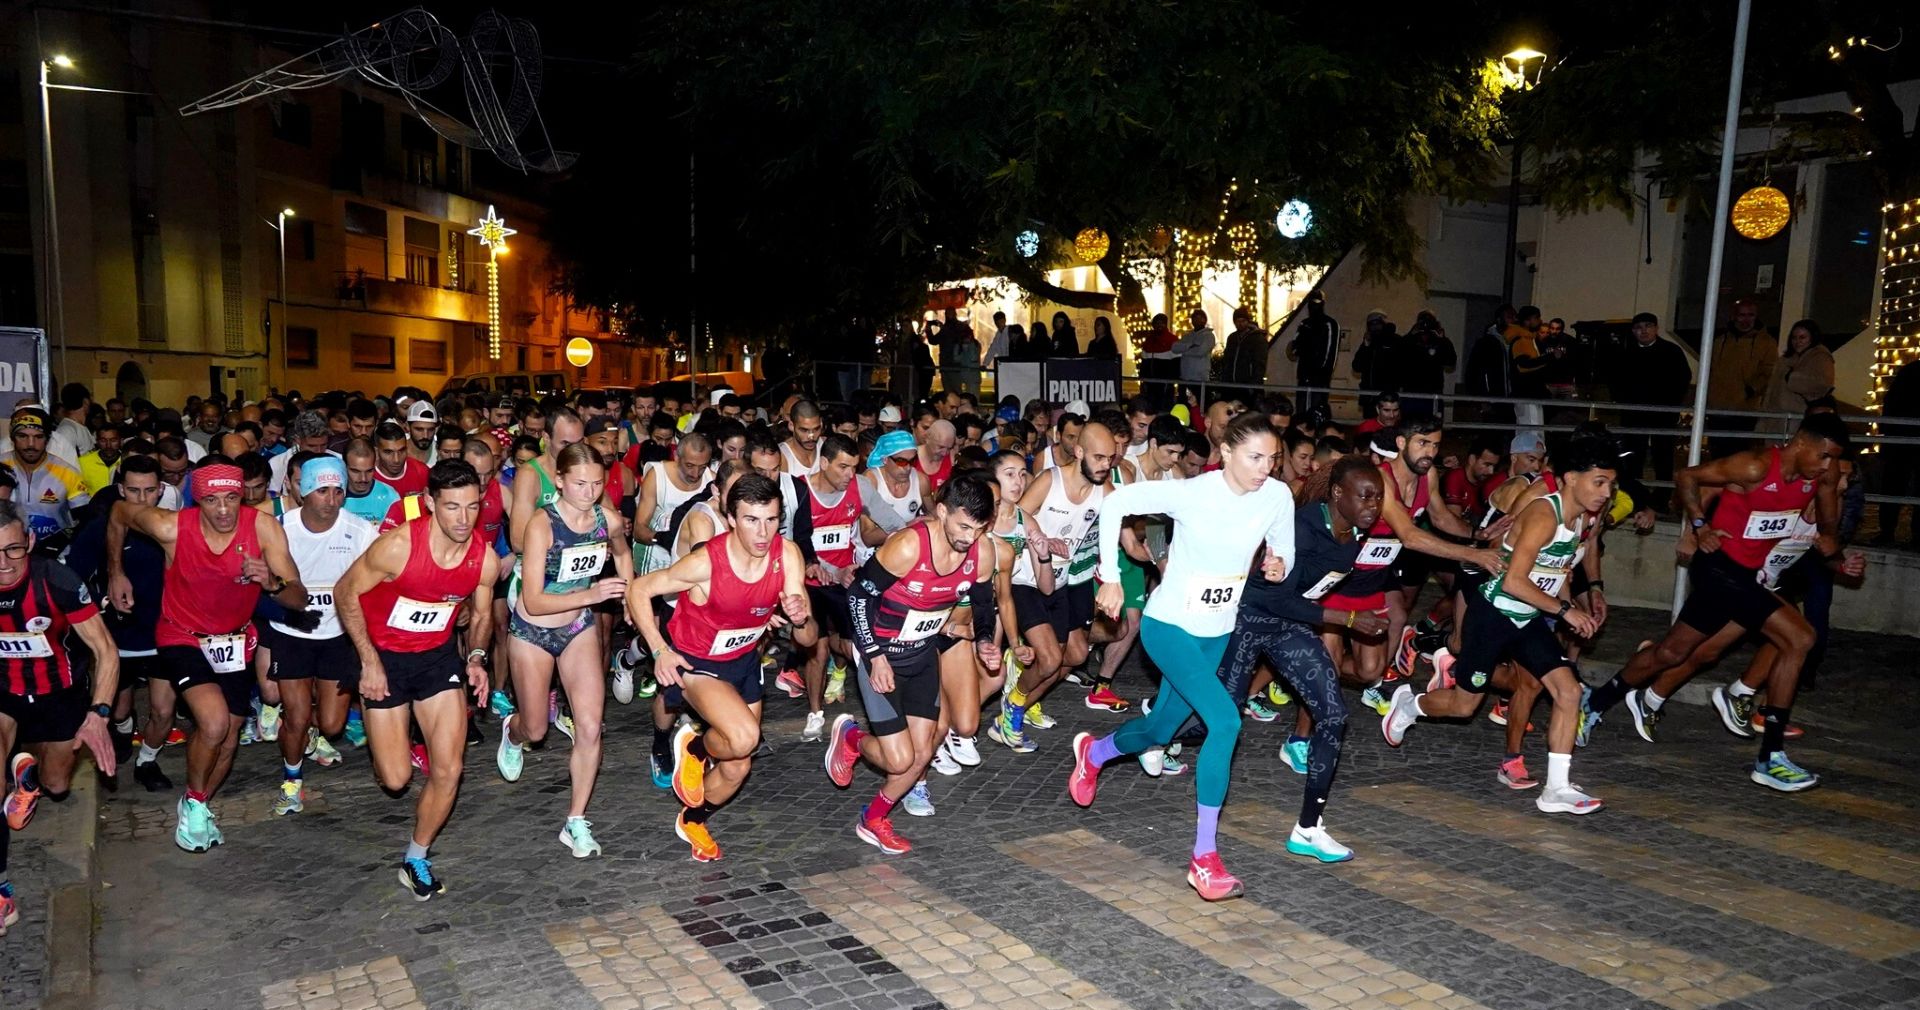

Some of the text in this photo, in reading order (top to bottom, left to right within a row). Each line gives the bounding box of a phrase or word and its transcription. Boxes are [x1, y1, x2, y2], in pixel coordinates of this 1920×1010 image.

[1049, 380, 1116, 402] PARTIDA
[1759, 519, 1787, 532] 343
[821, 533, 840, 544] 181
[1369, 546, 1389, 558] 478
[571, 555, 597, 572] 328
[1536, 577, 1557, 592] 527
[307, 594, 332, 606] 210
[1200, 587, 1233, 604] 433
[409, 611, 438, 625] 417
[914, 618, 942, 633] 480
[725, 633, 756, 648] 036
[209, 646, 234, 664] 302
